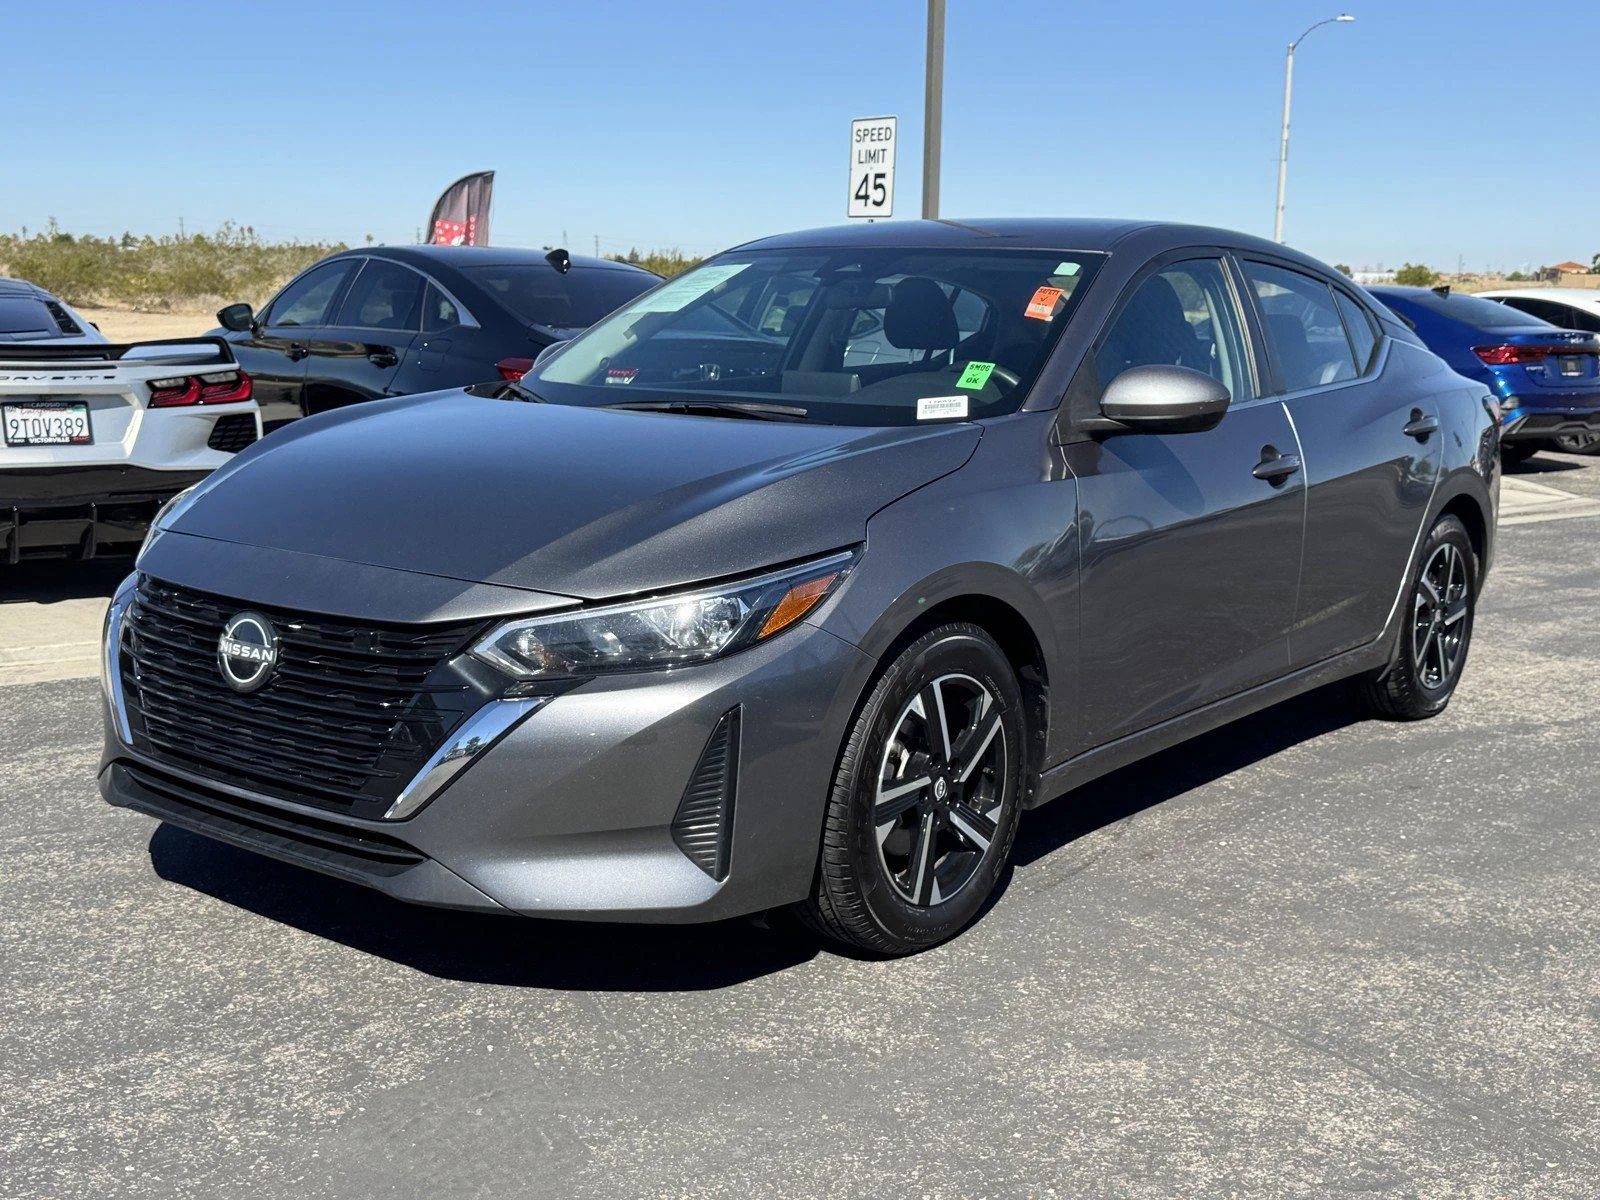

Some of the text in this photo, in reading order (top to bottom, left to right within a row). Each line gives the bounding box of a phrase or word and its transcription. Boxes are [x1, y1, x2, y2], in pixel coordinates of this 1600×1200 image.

[855, 127, 892, 142] SPEED
[858, 149, 887, 164] LIMIT
[855, 173, 886, 207] 45
[970, 363, 991, 372] SMOG
[29, 436, 70, 444] VICTORVILLE
[220, 639, 274, 662] NISSAN
